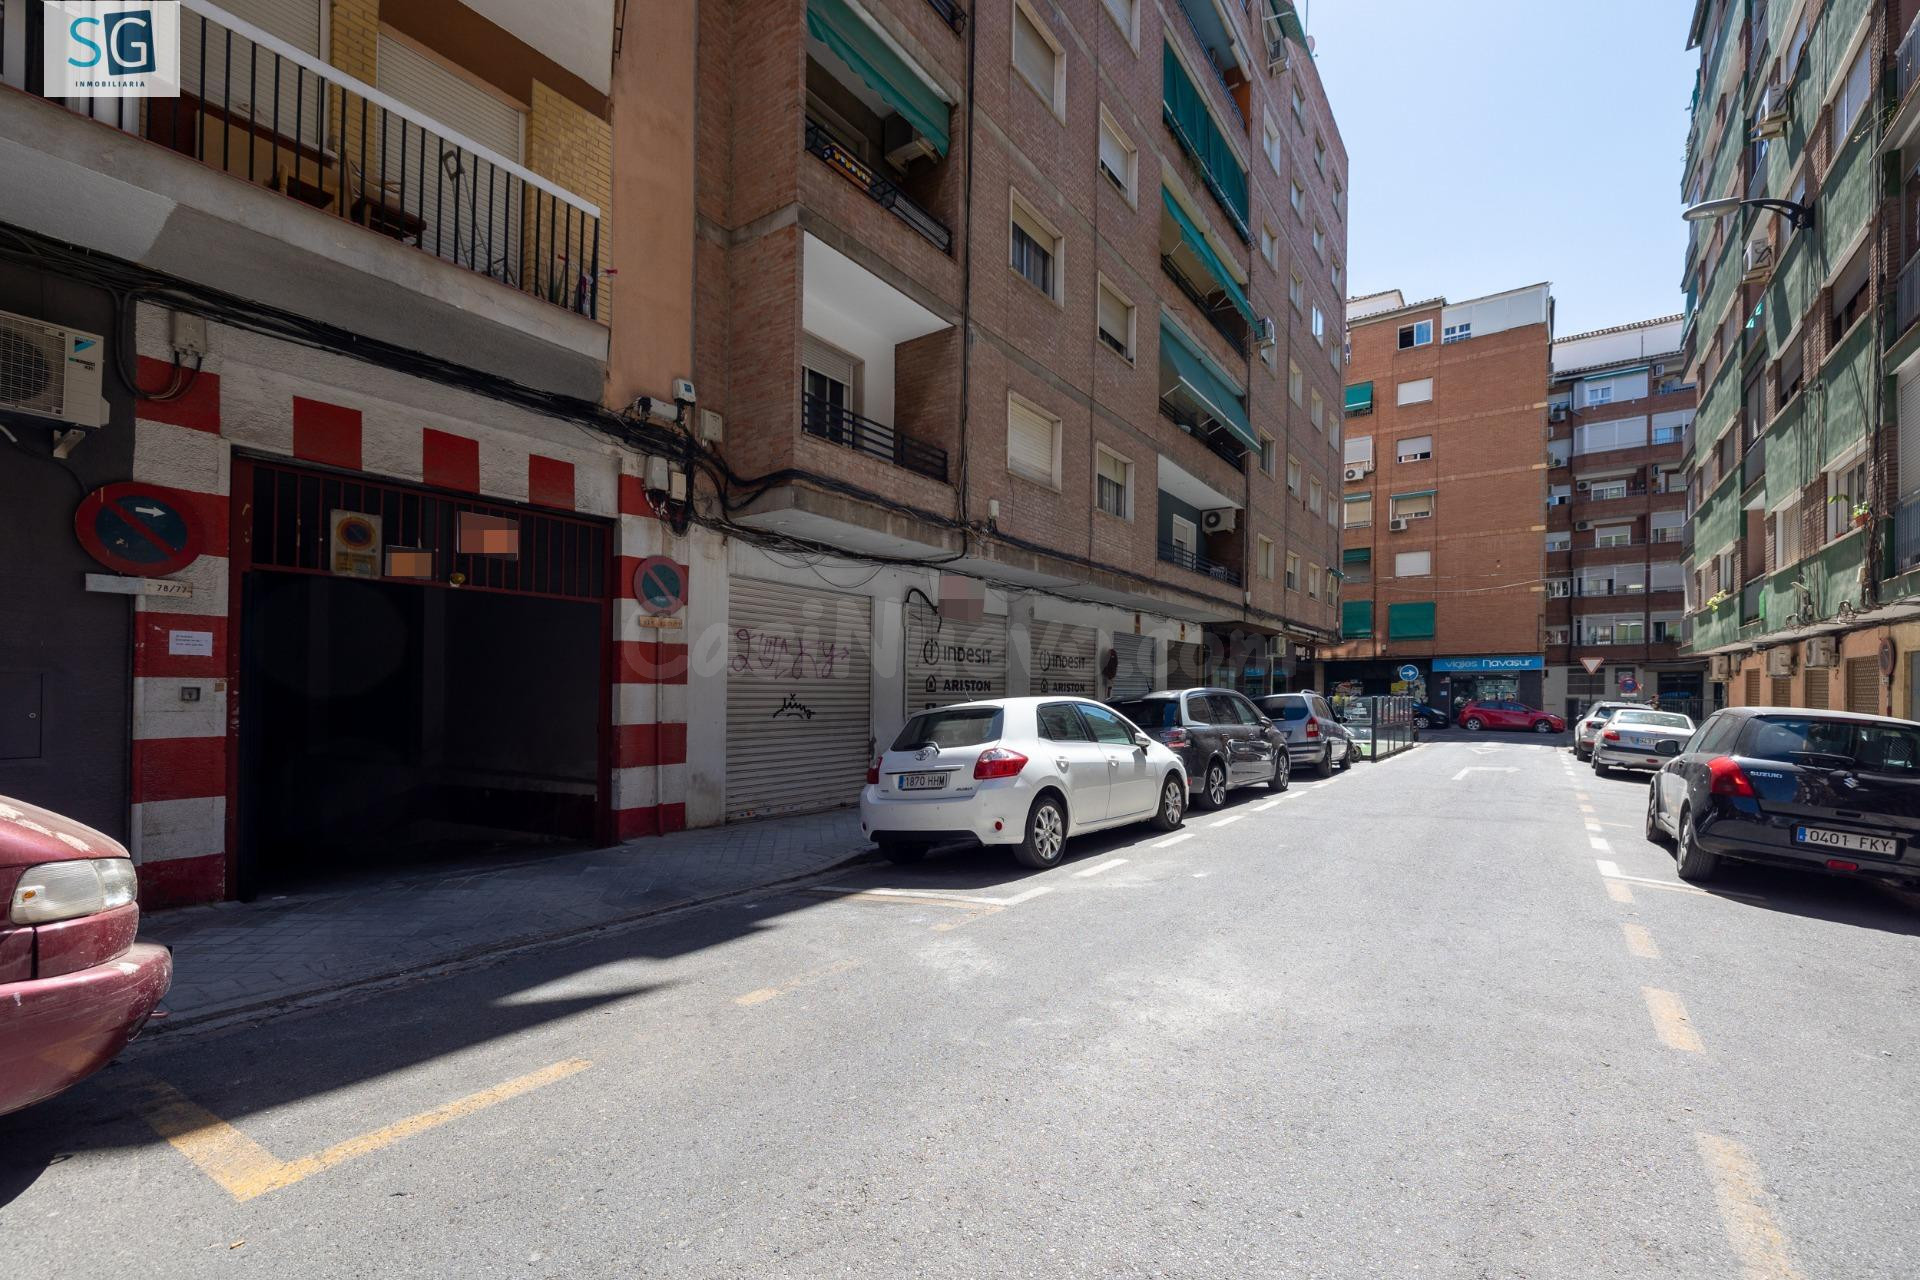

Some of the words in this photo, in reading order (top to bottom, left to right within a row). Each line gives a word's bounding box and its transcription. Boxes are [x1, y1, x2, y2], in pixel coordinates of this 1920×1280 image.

[1446, 659, 1478, 669] viajes
[943, 679, 991, 692] ARISTON
[1052, 683, 1085, 692] ARISTON
[1750, 770, 1783, 779] SUZUKI
[905, 775, 925, 788] 1870
[927, 774, 945, 788] HHM
[1809, 830, 1848, 846] 0401
[1859, 837, 1891, 852] FKY
